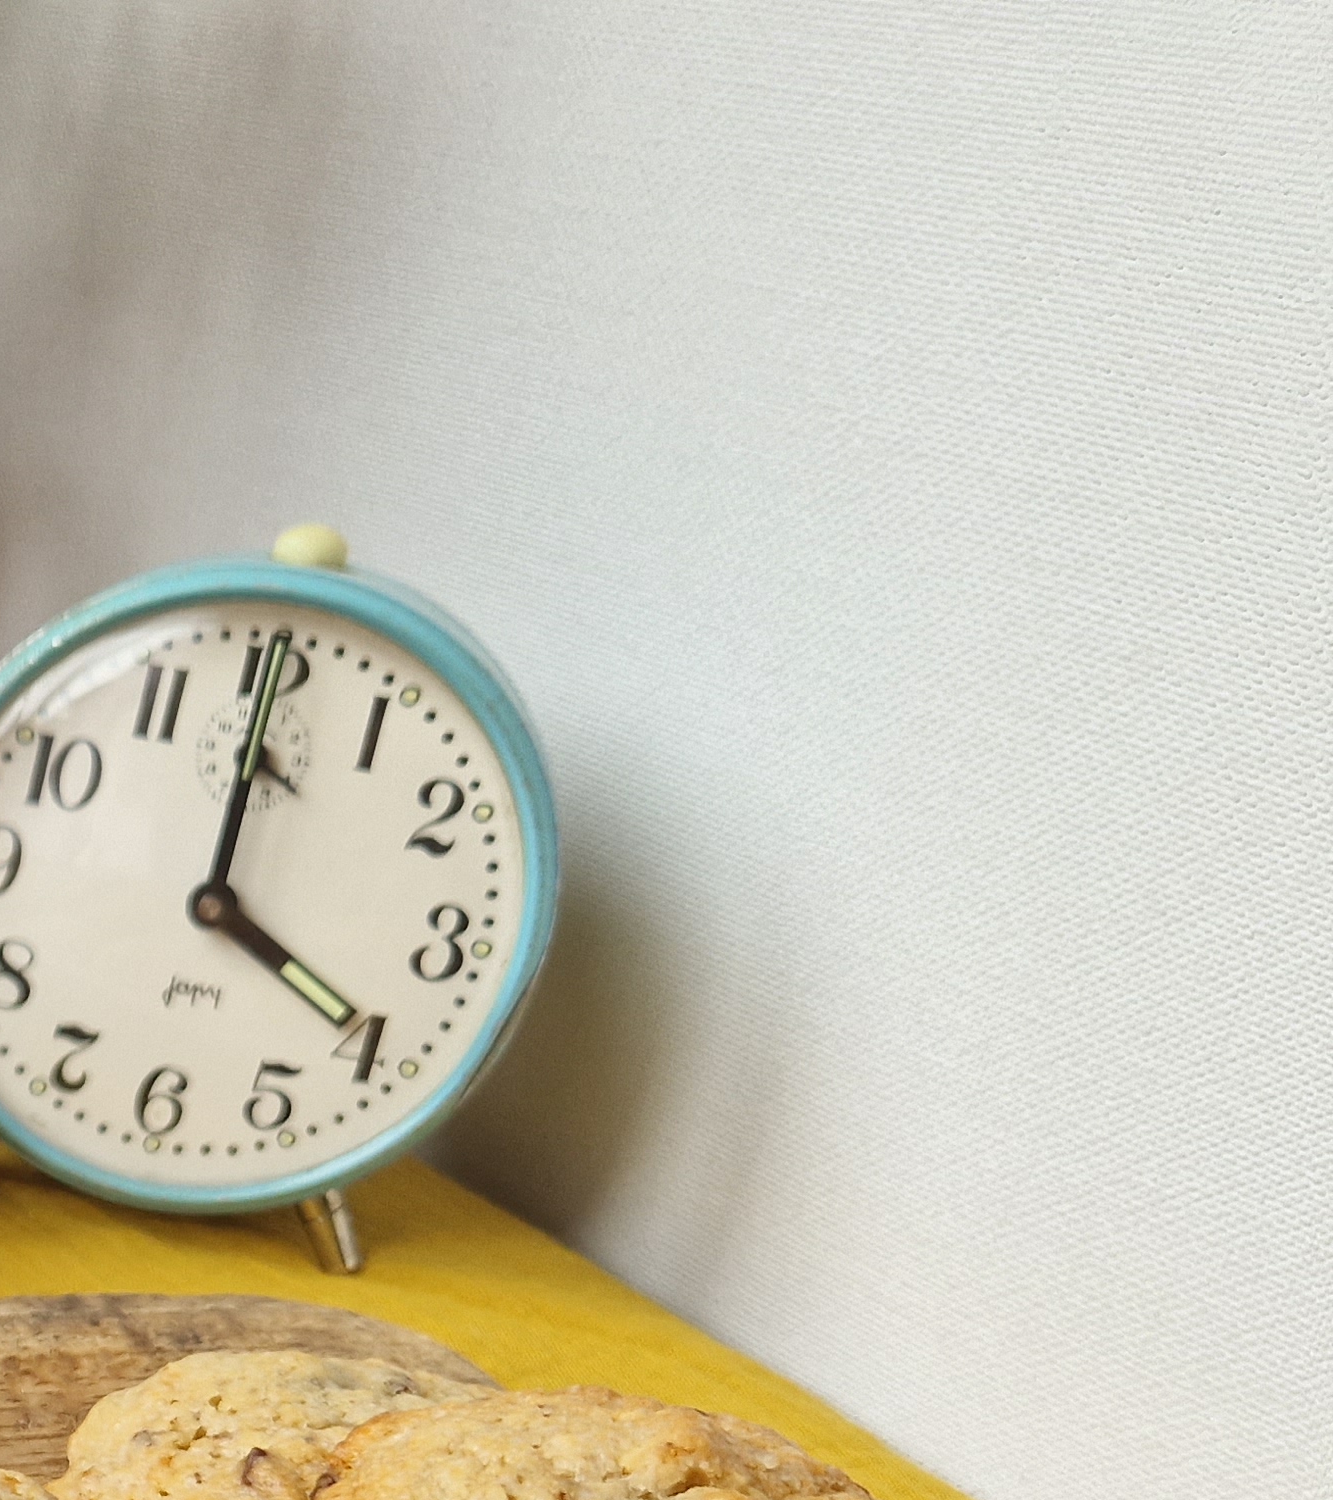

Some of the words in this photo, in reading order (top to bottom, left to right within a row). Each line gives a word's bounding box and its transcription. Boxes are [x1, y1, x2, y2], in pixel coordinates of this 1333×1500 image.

[355, 696, 391, 773] 1
[26, 735, 102, 810] 10
[405, 779, 464, 857] 2
[409, 905, 468, 981] 3
[49, 1023, 100, 1092] 7
[330, 1013, 388, 1084] 4
[134, 1066, 187, 1135] 6
[242, 1059, 303, 1131] 5
